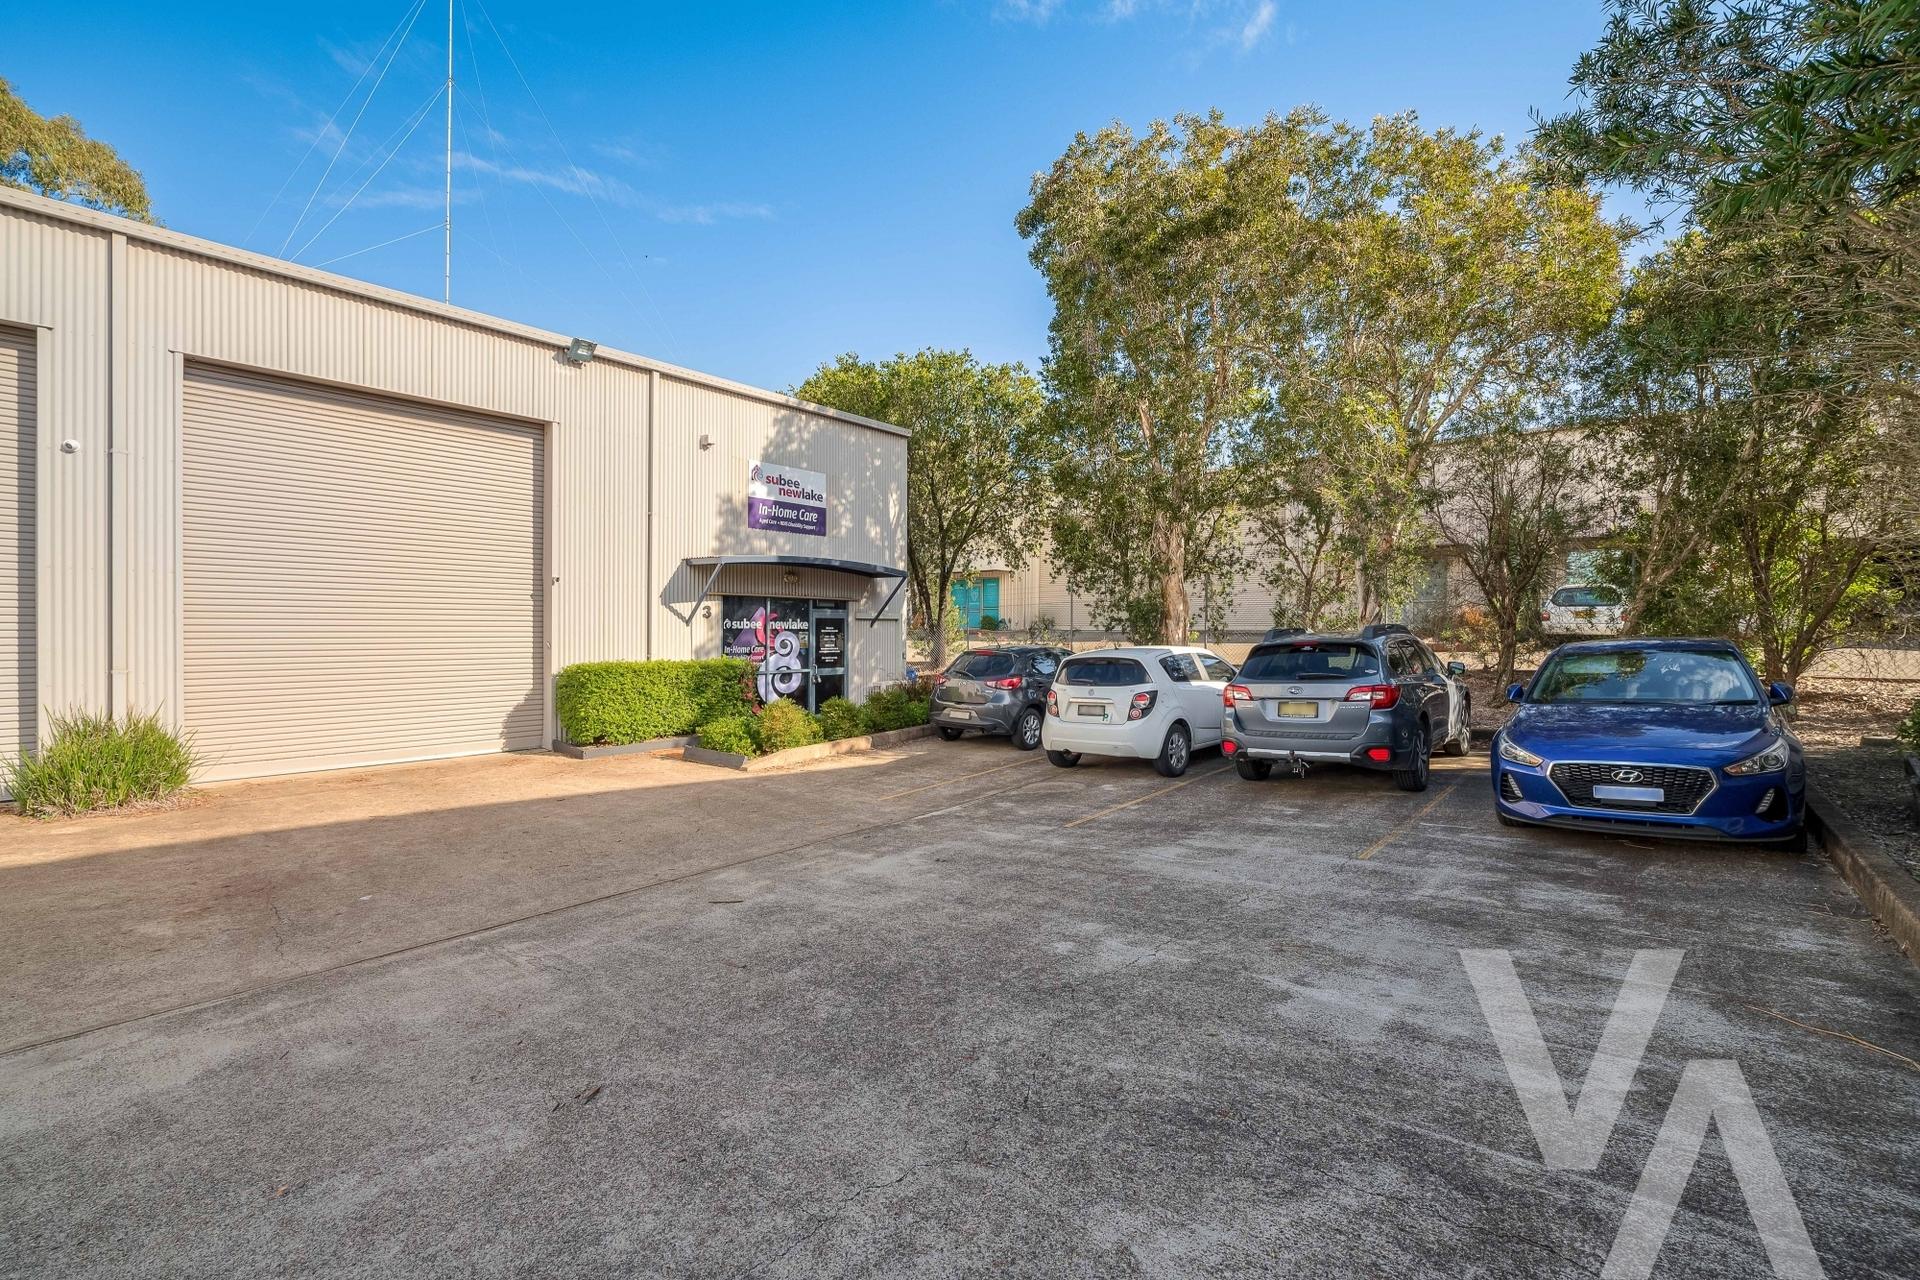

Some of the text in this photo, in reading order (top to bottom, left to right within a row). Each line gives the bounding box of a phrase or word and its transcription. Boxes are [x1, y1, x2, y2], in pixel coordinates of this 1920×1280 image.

[766, 474, 800, 489] subee
[778, 487, 823, 502] newlake
[758, 503, 818, 522] In-Home Care
[702, 605, 712, 619] 3
[732, 618, 762, 630] subee
[769, 618, 809, 630] newlake
[724, 645, 764, 654] In-Home Care
